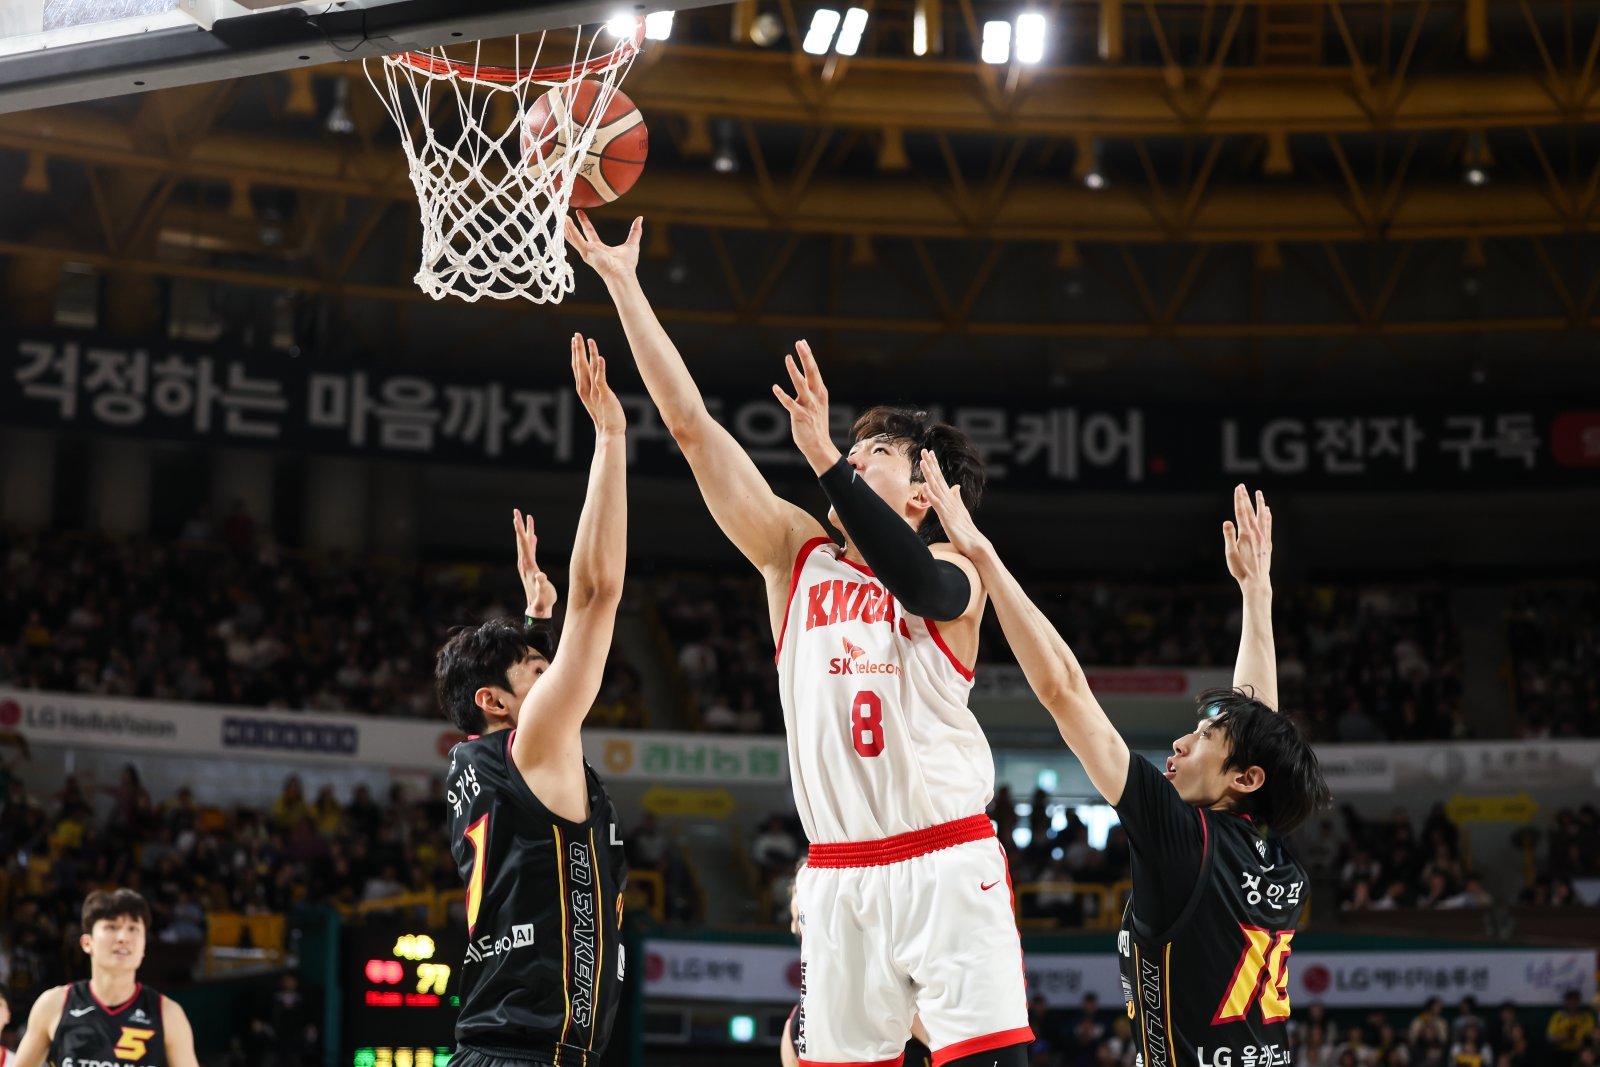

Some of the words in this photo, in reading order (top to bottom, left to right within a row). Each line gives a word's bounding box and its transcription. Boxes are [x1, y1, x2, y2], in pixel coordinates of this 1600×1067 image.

[15, 341, 288, 437] 걱정하는
[308, 372, 573, 461] 마음까지
[1439, 413, 1541, 470] 구독
[828, 657, 853, 676] SK
[26, 707, 57, 729] LG
[851, 690, 885, 758] 8
[447, 763, 481, 819] 유기상
[569, 841, 592, 886] GO
[1240, 871, 1304, 910] 정인덕
[571, 889, 595, 1027] SAKERS
[1142, 958, 1160, 1010] NO
[113, 1026, 158, 1061] 5
[1197, 1046, 1233, 1067] LG
